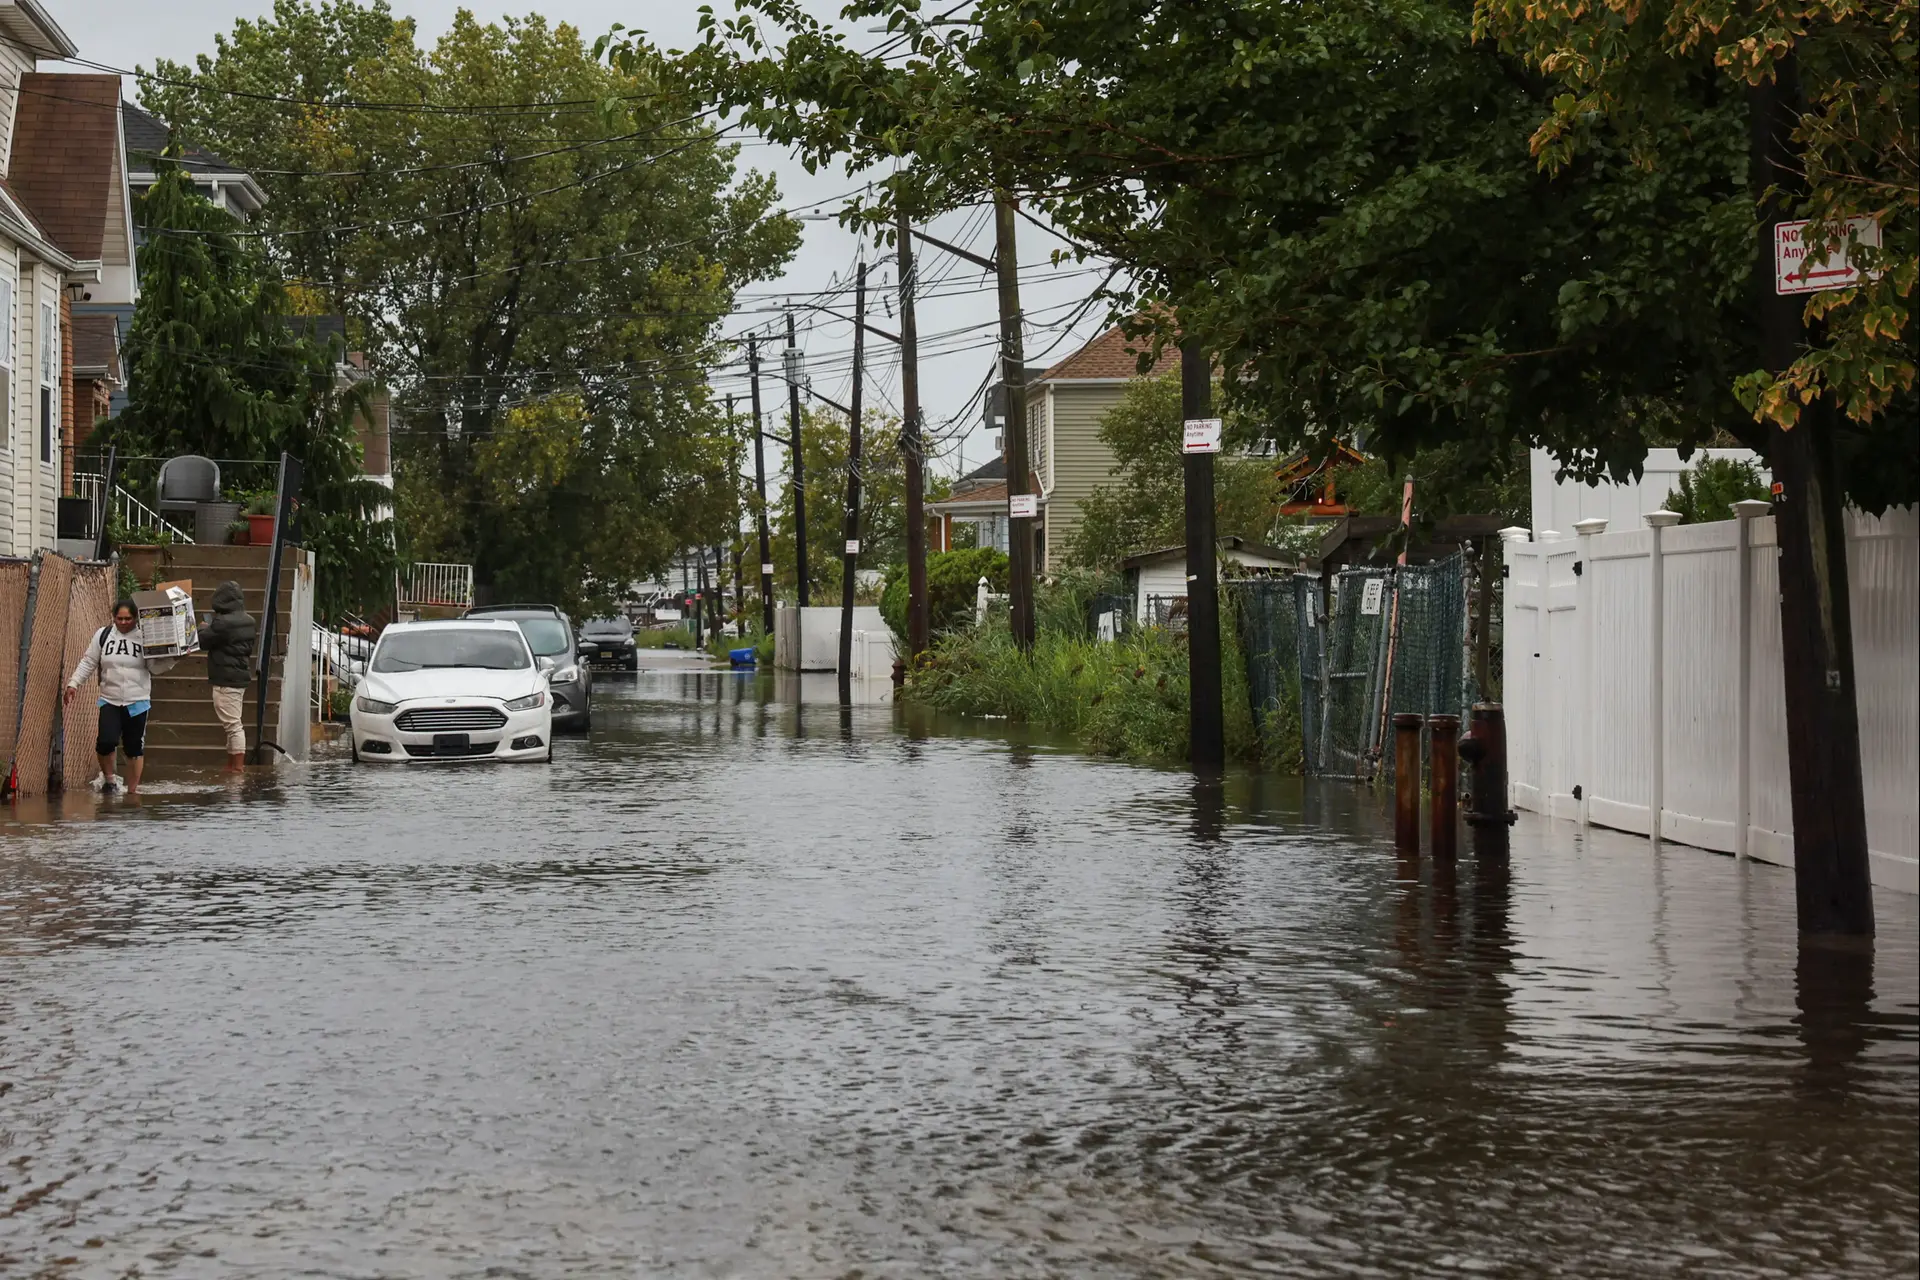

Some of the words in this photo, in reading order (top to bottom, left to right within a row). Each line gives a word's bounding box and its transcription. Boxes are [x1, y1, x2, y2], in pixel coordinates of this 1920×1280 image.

[1782, 230, 1799, 244] NO
[1783, 244, 1832, 260] Anyte
[1366, 583, 1379, 596] KEEP
[1366, 597, 1377, 610] OUT
[105, 639, 141, 657] GAP
